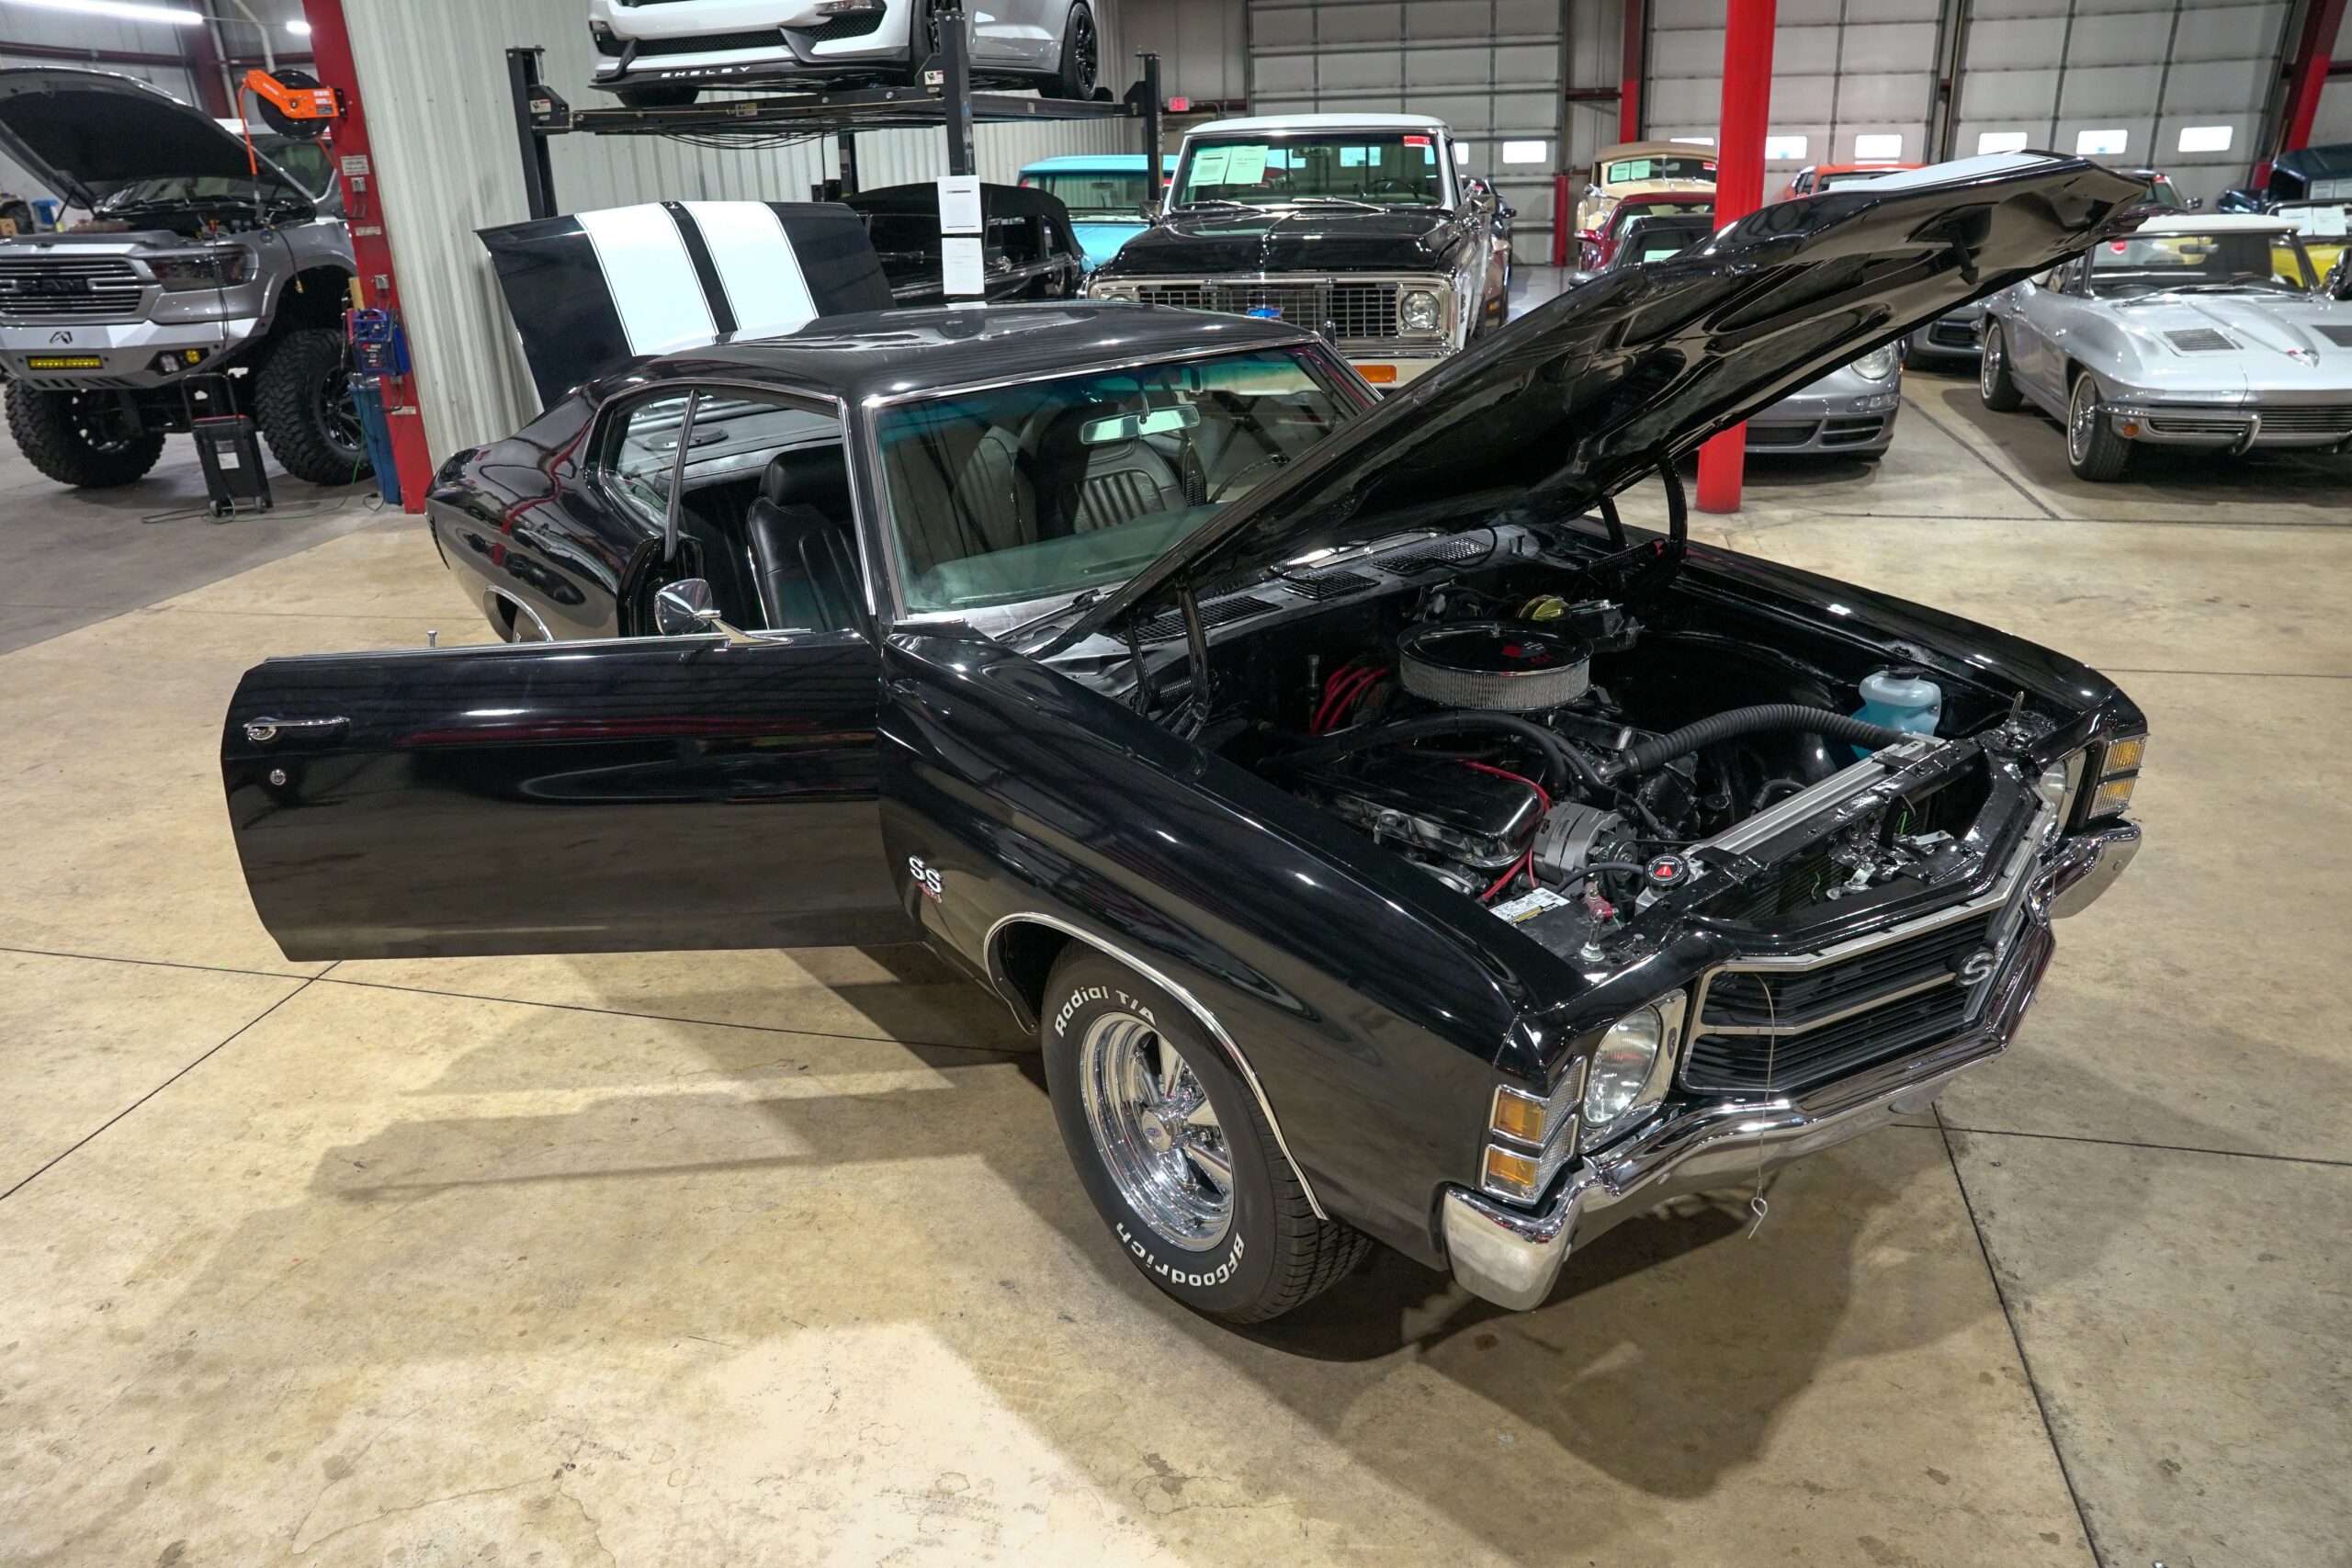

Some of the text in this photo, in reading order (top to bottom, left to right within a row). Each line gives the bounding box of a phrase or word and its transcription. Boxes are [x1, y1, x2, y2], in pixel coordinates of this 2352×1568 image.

[661, 66, 751, 78] SHELBY
[909, 855, 943, 893] SS
[1054, 986, 1110, 1038] Radial
[1115, 1222, 1245, 1287] BFGoodrich
